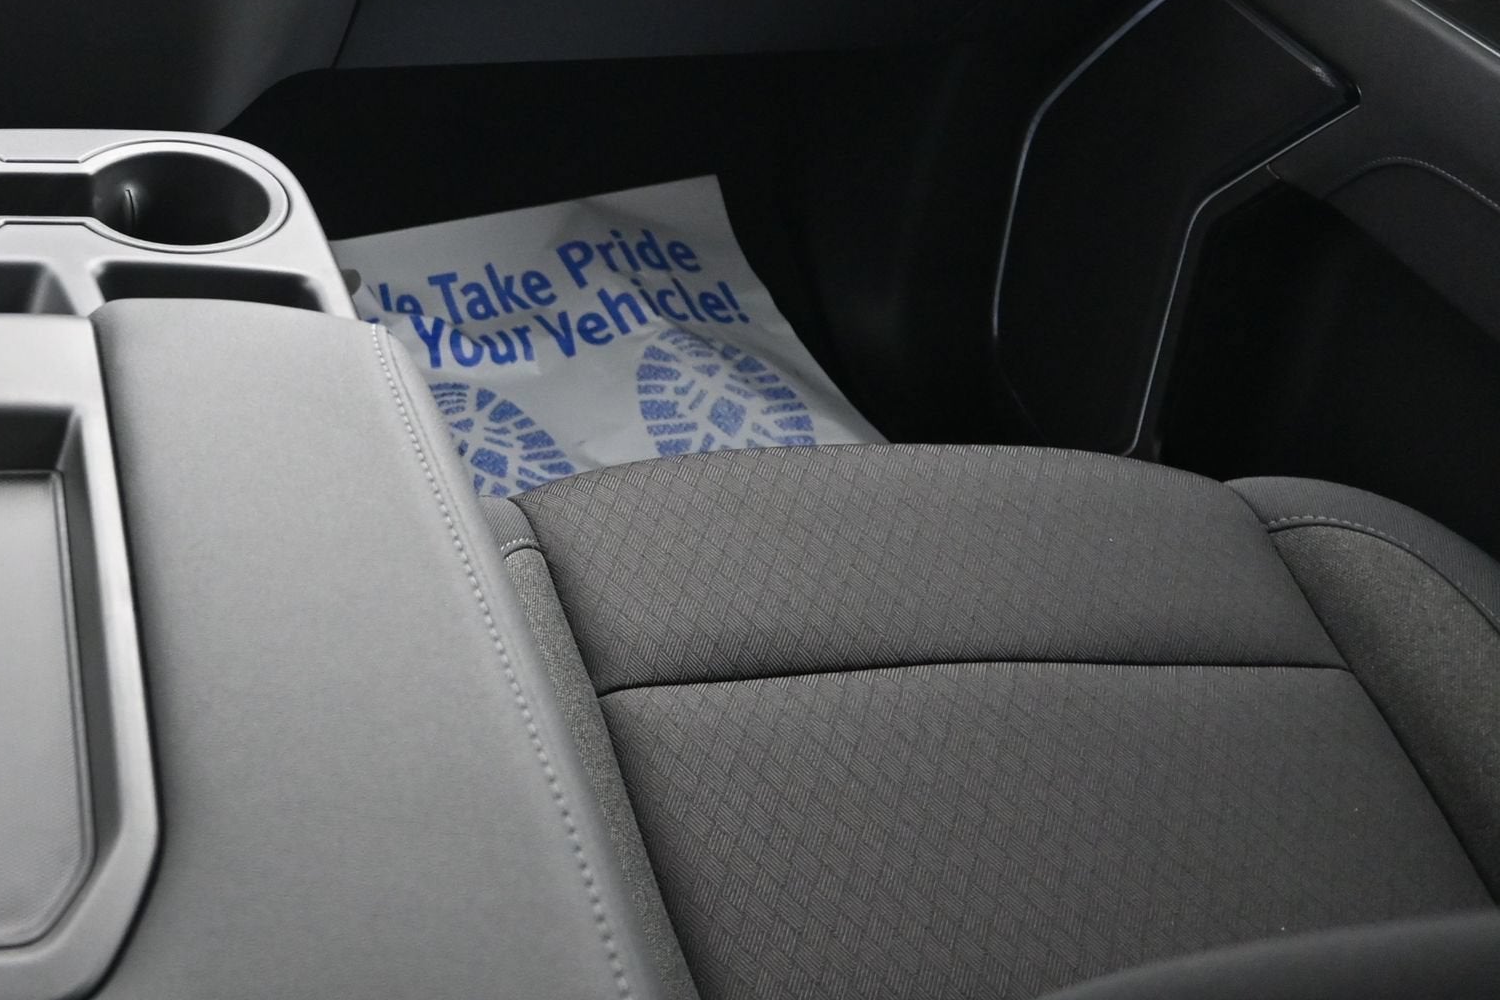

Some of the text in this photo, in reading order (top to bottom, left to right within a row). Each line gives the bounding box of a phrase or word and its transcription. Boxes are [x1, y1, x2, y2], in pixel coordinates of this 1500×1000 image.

[409, 278, 749, 369] Your Vehicle!
[428, 262, 557, 325] Take
[556, 229, 702, 289] Pride
